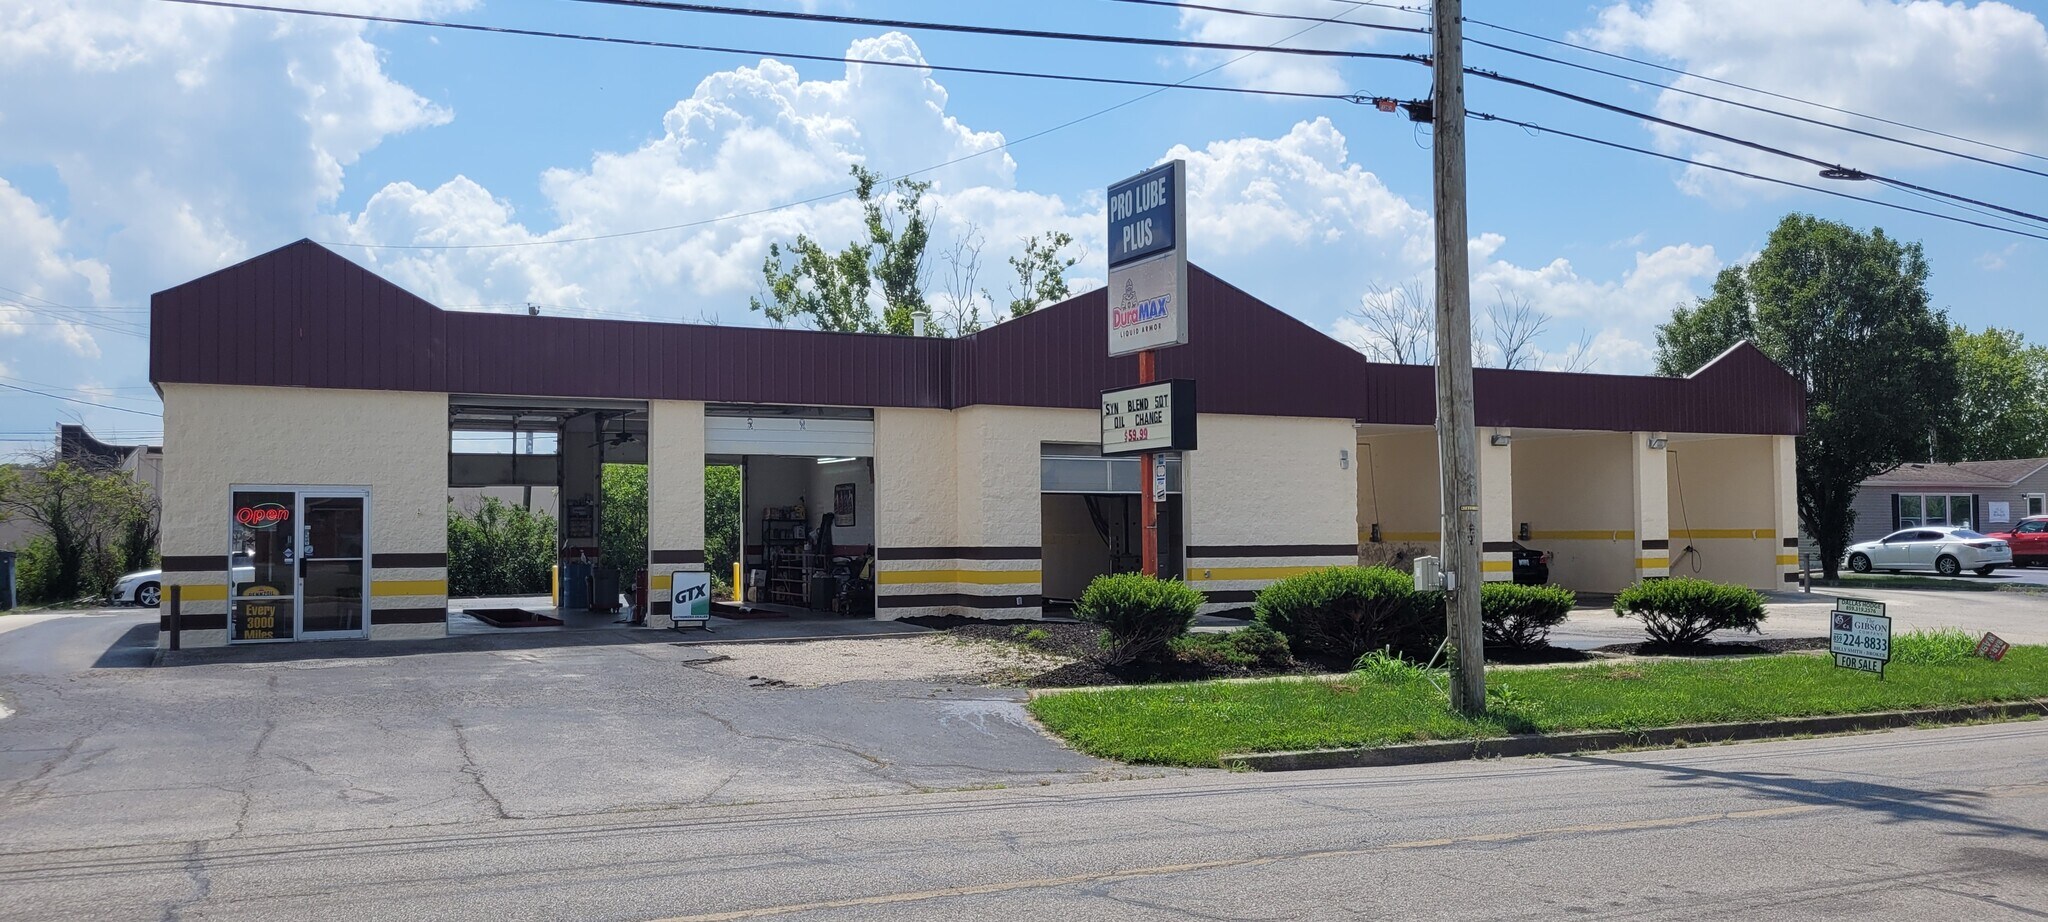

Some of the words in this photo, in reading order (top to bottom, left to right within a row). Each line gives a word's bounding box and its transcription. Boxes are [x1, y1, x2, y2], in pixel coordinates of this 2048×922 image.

[1110, 189, 1133, 224] PRO
[1136, 176, 1167, 214] LUBE
[1123, 217, 1153, 254] PLUS
[1112, 296, 1169, 330] DuraMAX
[1120, 328, 1139, 338] LIQUID
[1141, 323, 1162, 333] ARMOR
[1105, 402, 1119, 416] SYN
[1127, 398, 1149, 413] BLEND
[1154, 394, 1169, 409] 5QT
[1114, 416, 1125, 429] OIL
[1135, 411, 1162, 426] CHANGE
[1124, 427, 1148, 442] $59.99
[236, 507, 290, 524] Open
[675, 582, 707, 604] GTX
[245, 604, 276, 617] Every
[247, 616, 275, 629] 3000
[1854, 621, 1888, 632] GIBSON
[244, 629, 274, 639] Miles
[1843, 633, 1887, 651] 224-8833
[1841, 656, 1857, 668] FOR
[1858, 659, 1878, 671] SALE
